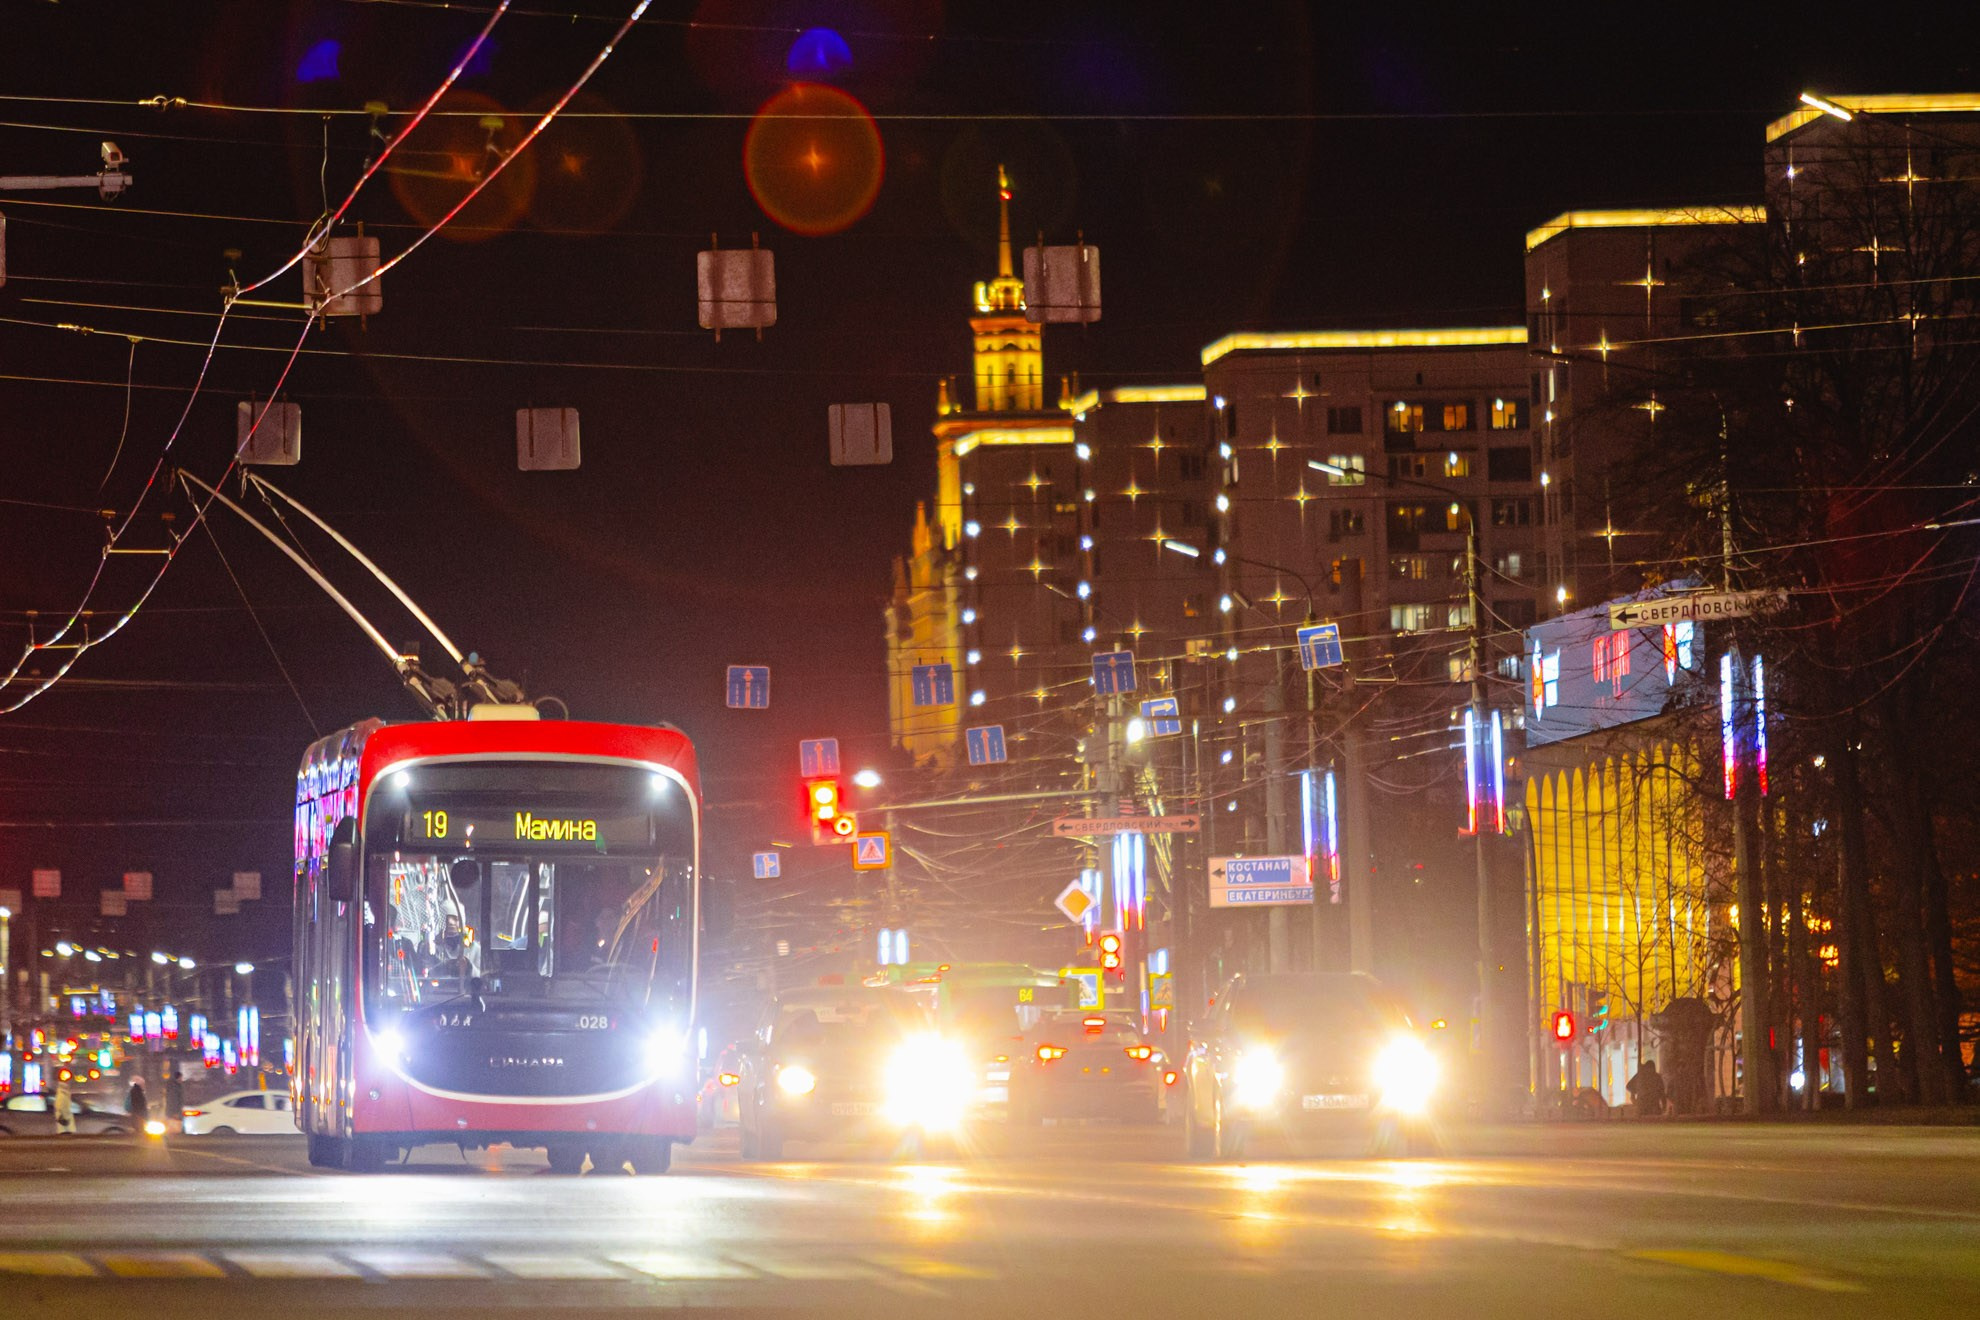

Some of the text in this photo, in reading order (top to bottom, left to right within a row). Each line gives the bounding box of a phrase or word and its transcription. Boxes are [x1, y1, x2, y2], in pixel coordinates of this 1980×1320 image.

[423, 810, 448, 839] 19
[516, 811, 597, 841] Мамина
[1074, 820, 1161, 832] СВЕРДЛОВСКИЙ
[1228, 861, 1290, 873] КОСТАНАЙ
[1229, 873, 1254, 883] УФА
[1018, 988, 1033, 1003] 64
[580, 1015, 608, 1029] 028
